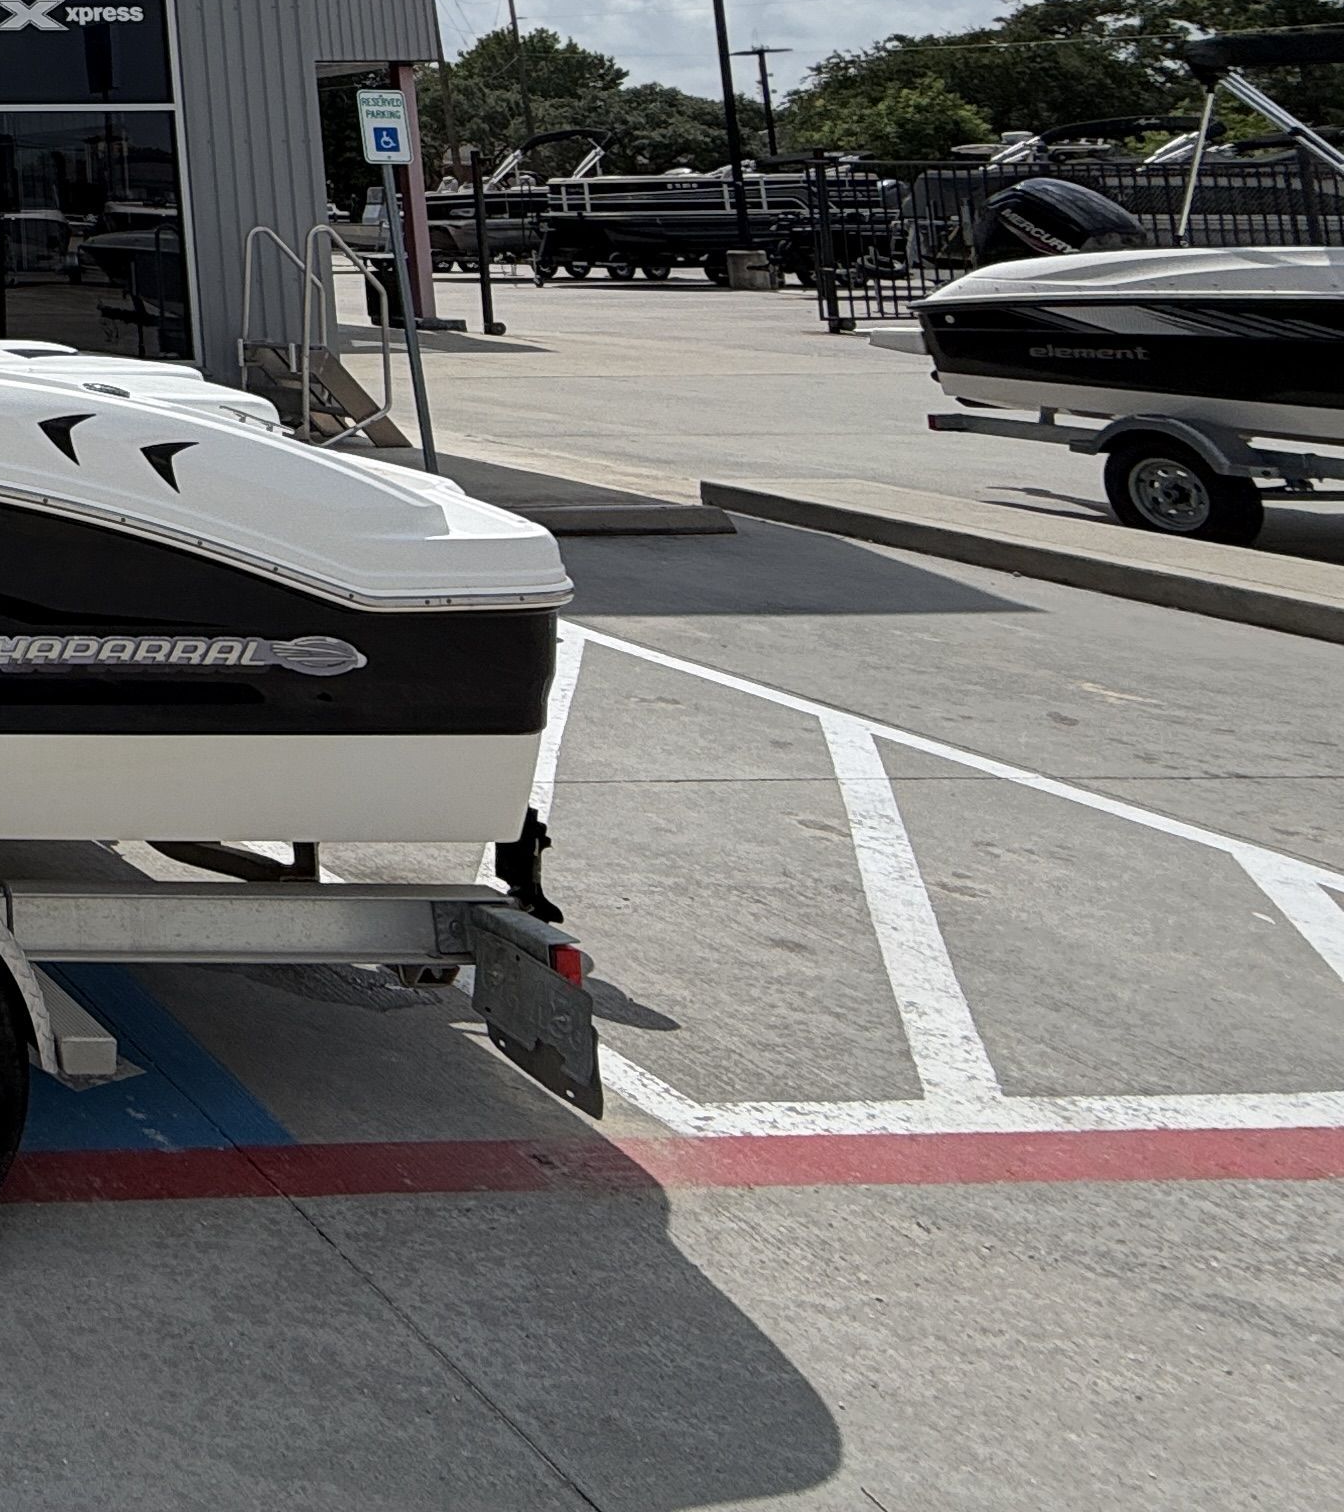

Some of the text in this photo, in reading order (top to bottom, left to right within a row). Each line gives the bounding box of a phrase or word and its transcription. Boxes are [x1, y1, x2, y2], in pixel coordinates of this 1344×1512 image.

[65, 6, 144, 25] xpress
[360, 97, 403, 108] RESERVED
[365, 109, 402, 120] PARKING
[1001, 208, 1081, 254] MERCURY
[1029, 344, 1151, 361] element
